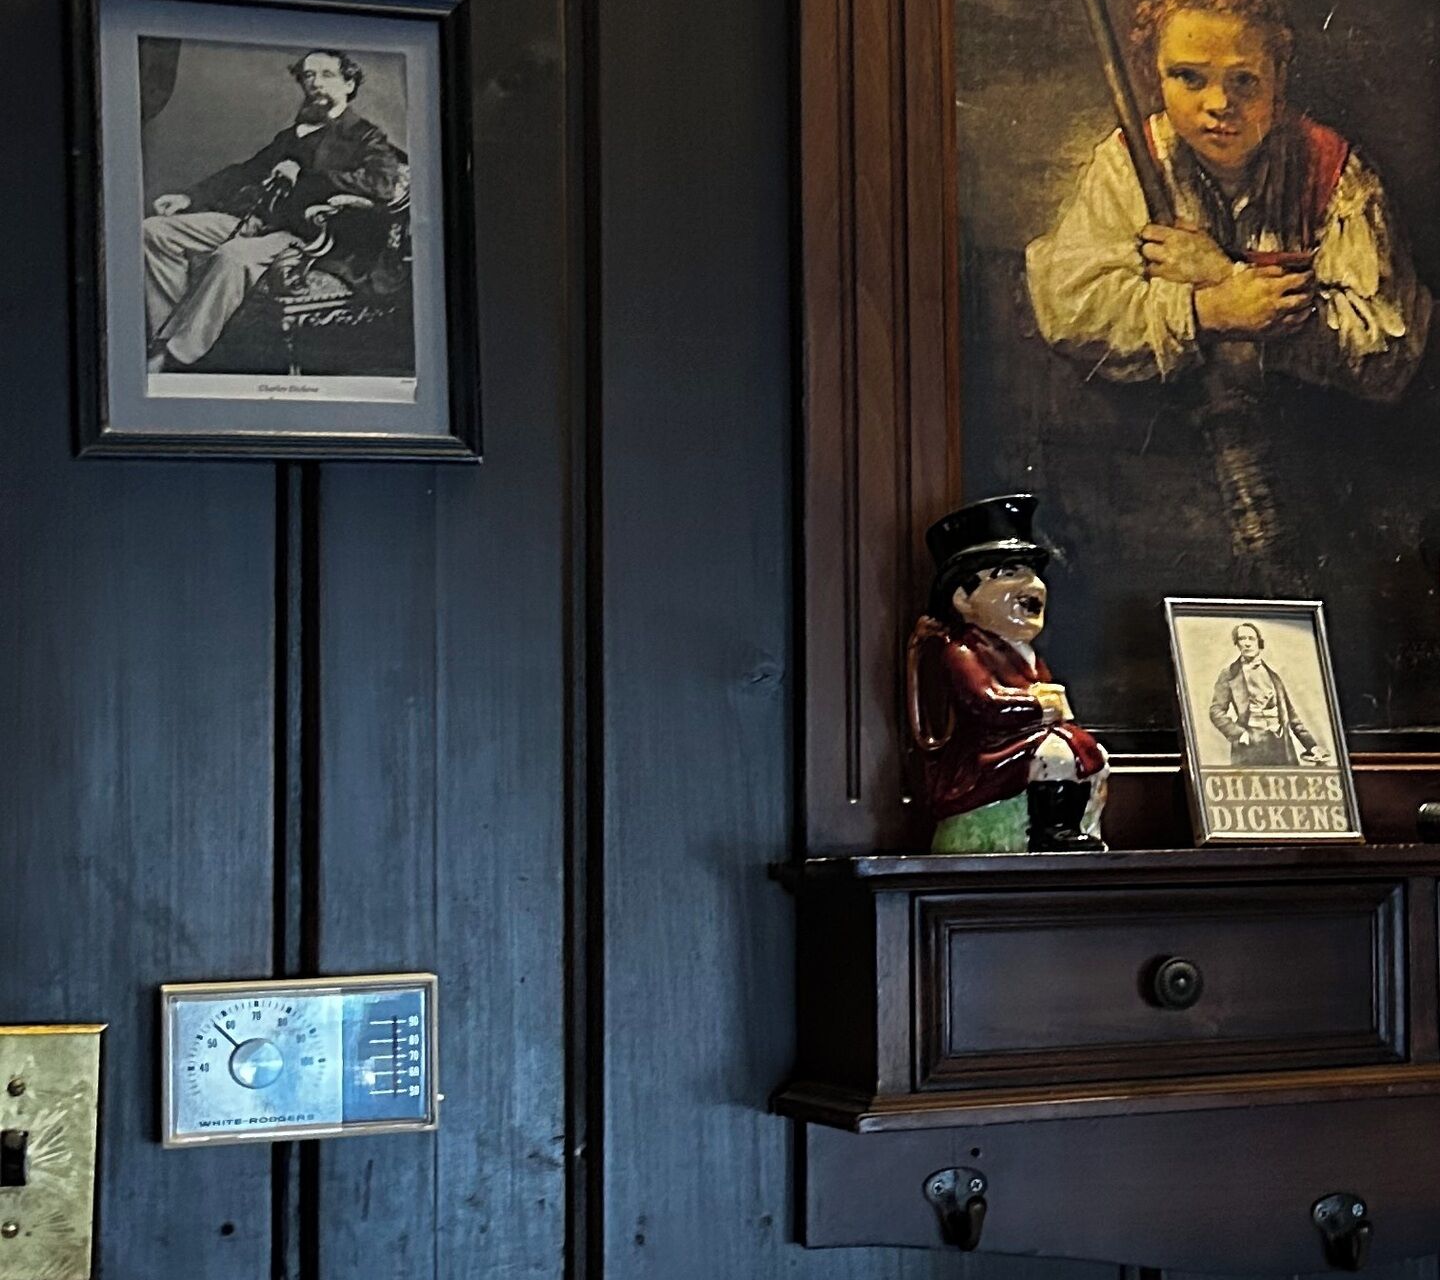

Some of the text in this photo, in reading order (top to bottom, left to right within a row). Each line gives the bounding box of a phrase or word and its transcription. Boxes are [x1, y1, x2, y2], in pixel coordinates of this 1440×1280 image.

[1205, 775, 1343, 802] CHARLES
[1209, 805, 1348, 831] DICKENS
[199, 1113, 315, 1127] WHITE-RODGERS
